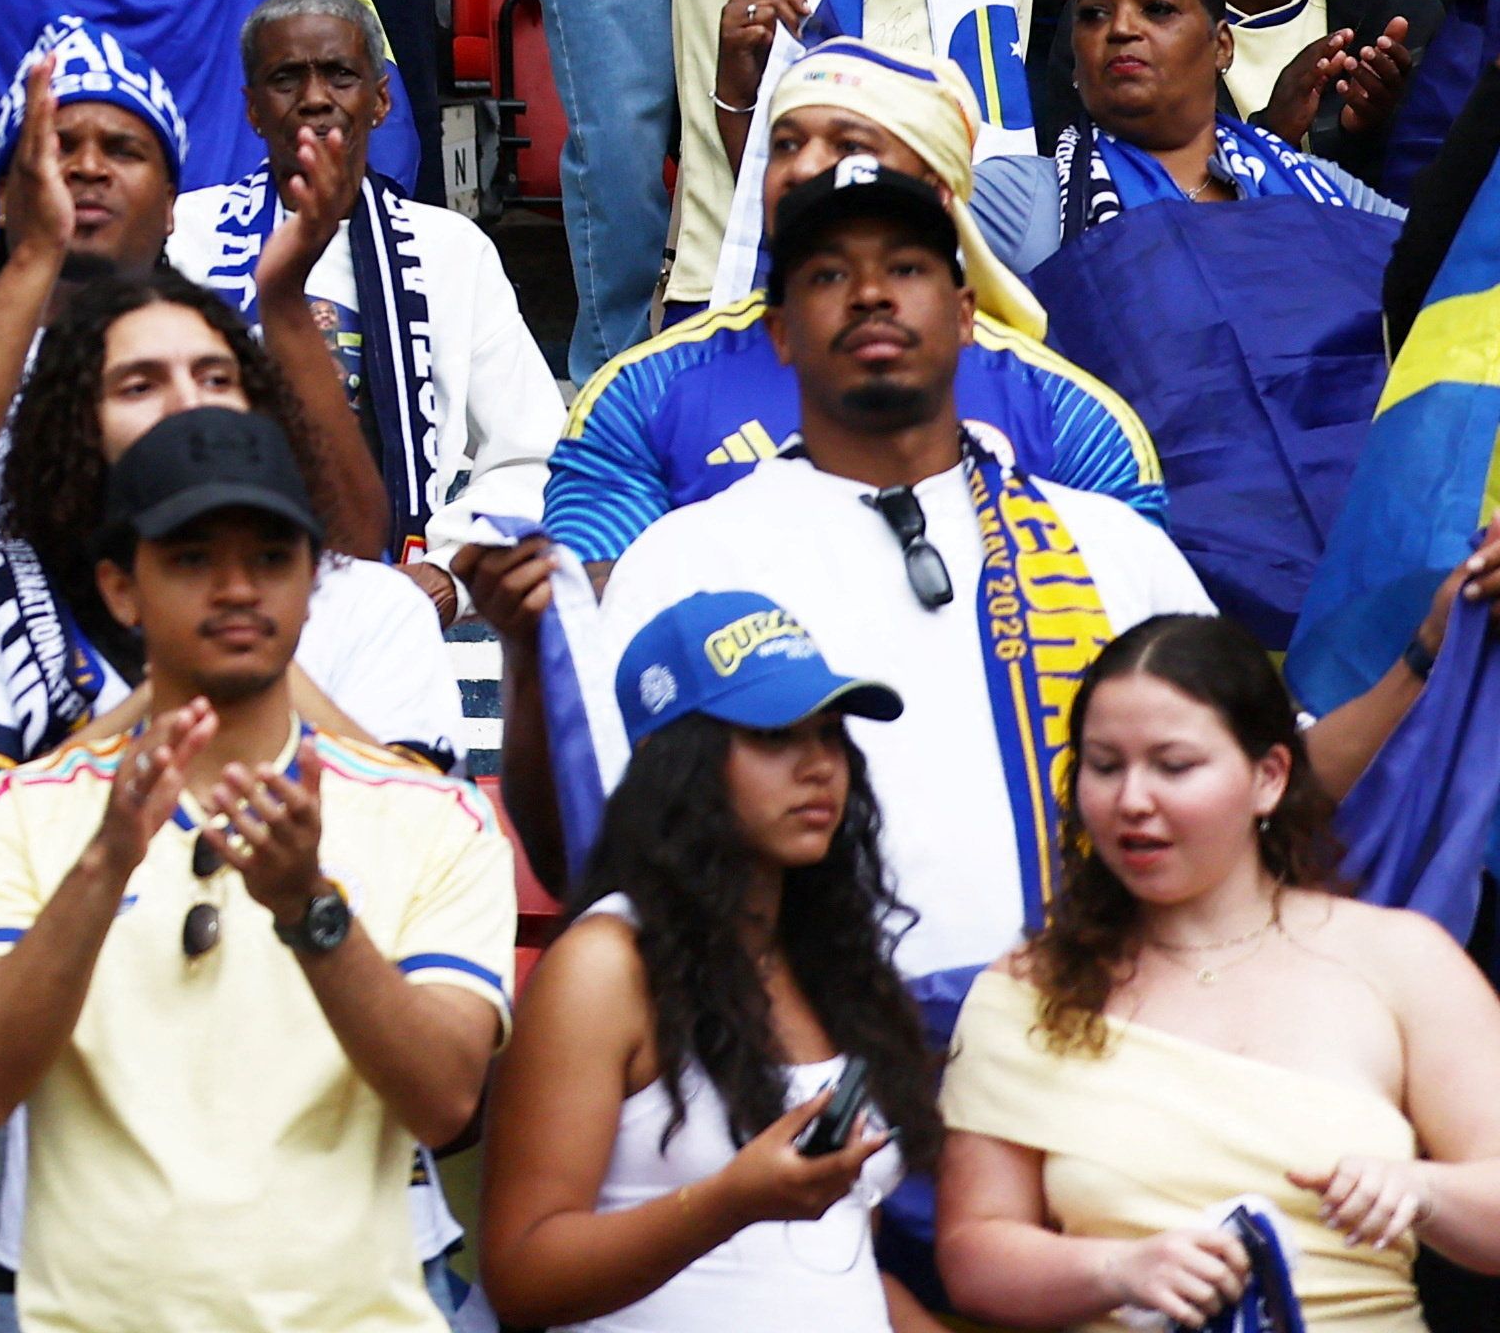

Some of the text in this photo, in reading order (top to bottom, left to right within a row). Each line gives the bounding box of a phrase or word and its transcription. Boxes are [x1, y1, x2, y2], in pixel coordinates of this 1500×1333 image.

[454, 147, 467, 187] N
[977, 509, 1011, 570] MAY
[990, 576, 1030, 662] 2026
